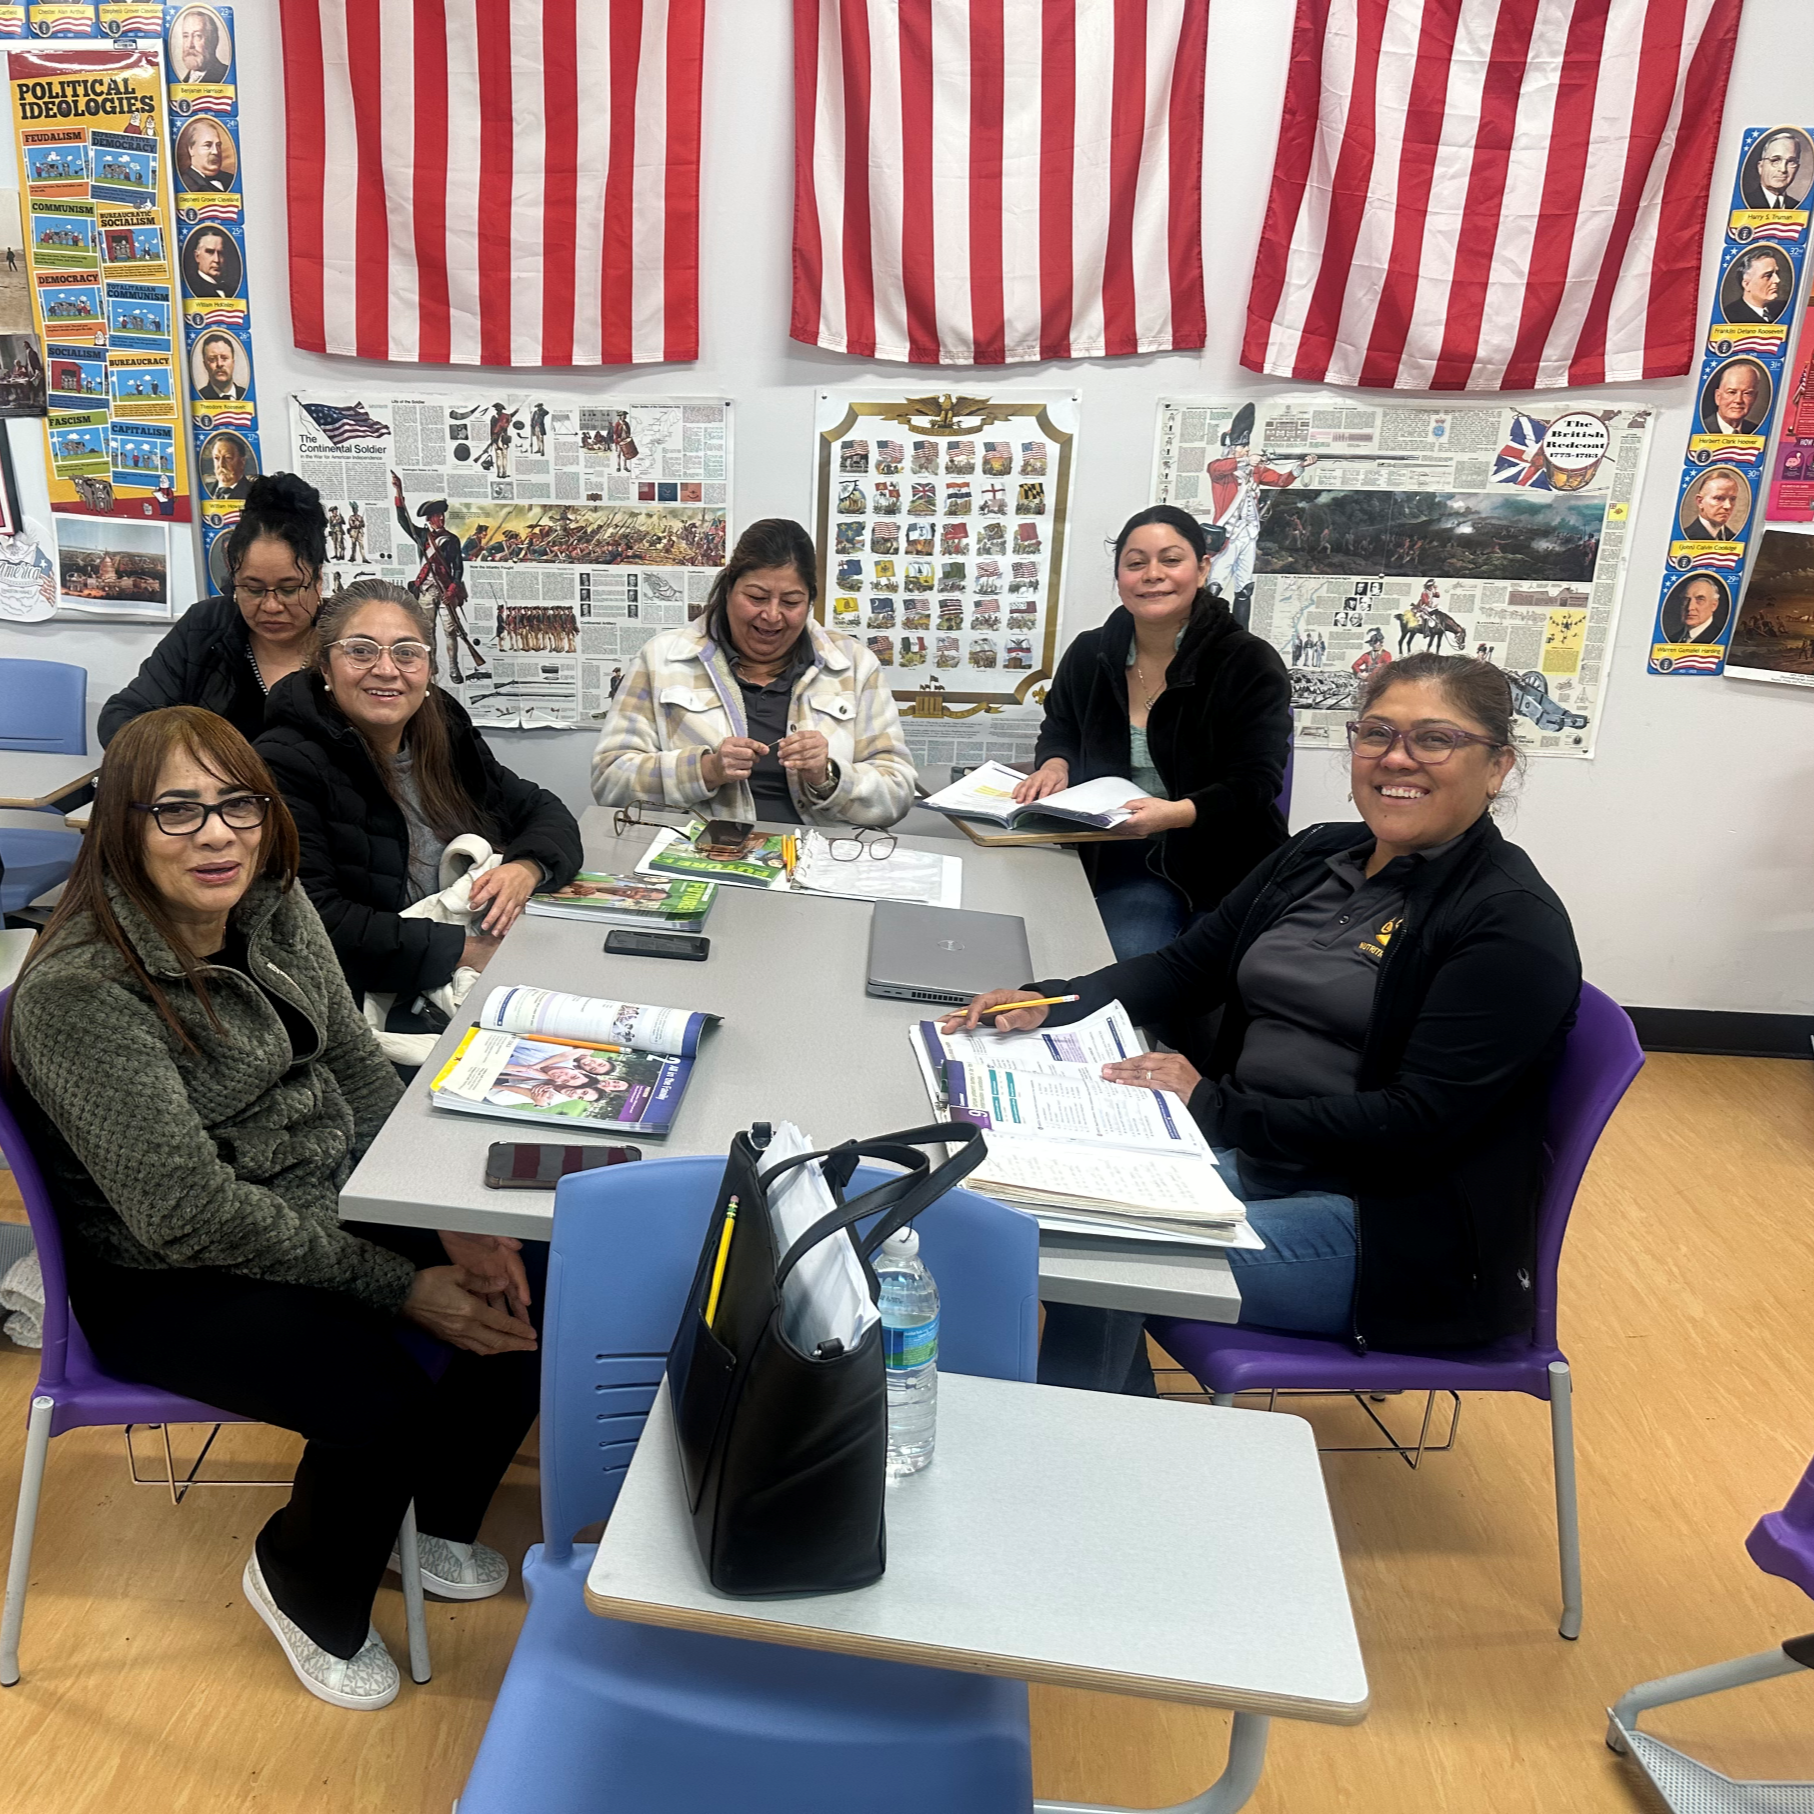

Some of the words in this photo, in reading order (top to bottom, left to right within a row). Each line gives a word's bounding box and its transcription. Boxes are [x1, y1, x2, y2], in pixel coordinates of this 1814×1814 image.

[18, 78, 136, 101] POLITICAL
[20, 95, 155, 120] IDEOLOGIES
[24, 132, 82, 142] FEUDALISM
[92, 138, 156, 154] DEMOCRACY
[32, 203, 94, 214] COMMUNISM
[99, 211, 152, 219] BUREAUCRATIC
[101, 217, 156, 227] SOCIALISM
[38, 274, 98, 284] DEMOCRACY
[107, 284, 155, 292] TOTALITARIAN
[107, 290, 169, 301] COMMUNISM
[48, 347, 101, 359] SOCIALISM
[109, 357, 169, 367] BUREAUCRACY
[48, 416, 91, 427] FASCISM
[111, 425, 171, 437] CAPITALISM
[1551, 430, 1605, 438] British
[299, 435, 317, 443] The
[299, 443, 352, 453] Continental
[354, 444, 387, 454] Soldier
[1546, 441, 1605, 449] Redcoat
[678, 859, 771, 877] FUTURE
[677, 882, 708, 910] FUTURE
[663, 1077, 675, 1085] the
[655, 1085, 672, 1100] Family
[968, 1109, 988, 1118] 9
